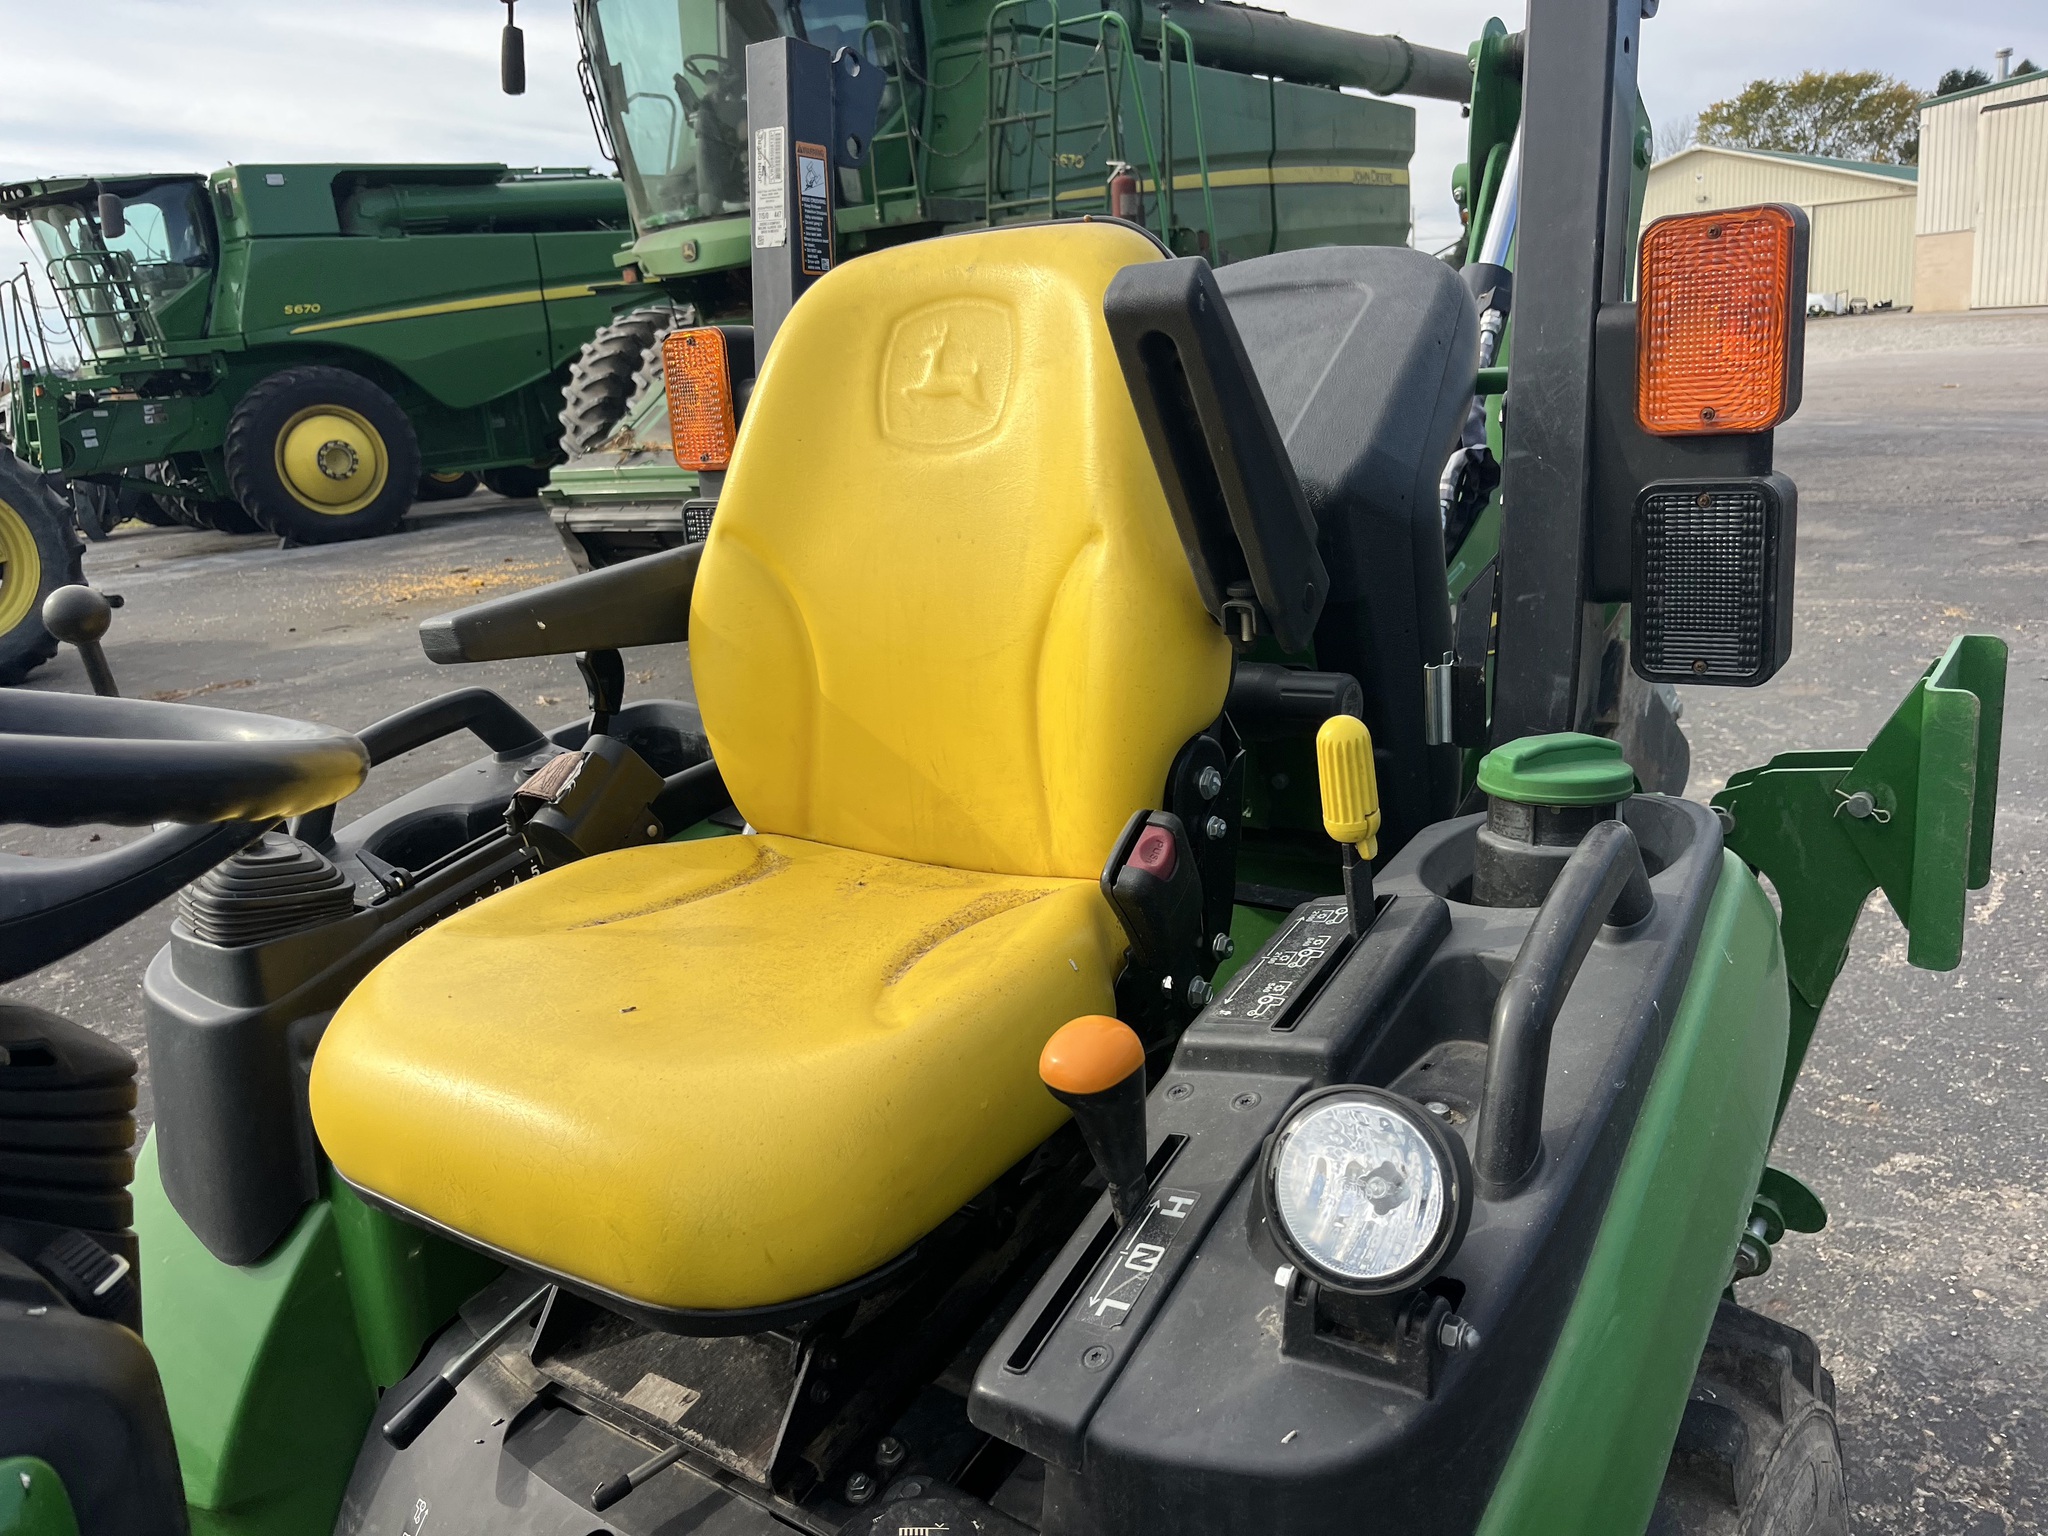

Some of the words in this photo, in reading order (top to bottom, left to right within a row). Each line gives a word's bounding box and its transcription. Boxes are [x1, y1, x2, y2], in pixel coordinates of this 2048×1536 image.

[284, 303, 321, 315] S670
[1145, 839, 1164, 864] PUSH
[530, 864, 541, 877] 5
[1160, 1195, 1195, 1219] H
[1130, 1246, 1160, 1268] N
[1094, 1297, 1131, 1316] L
